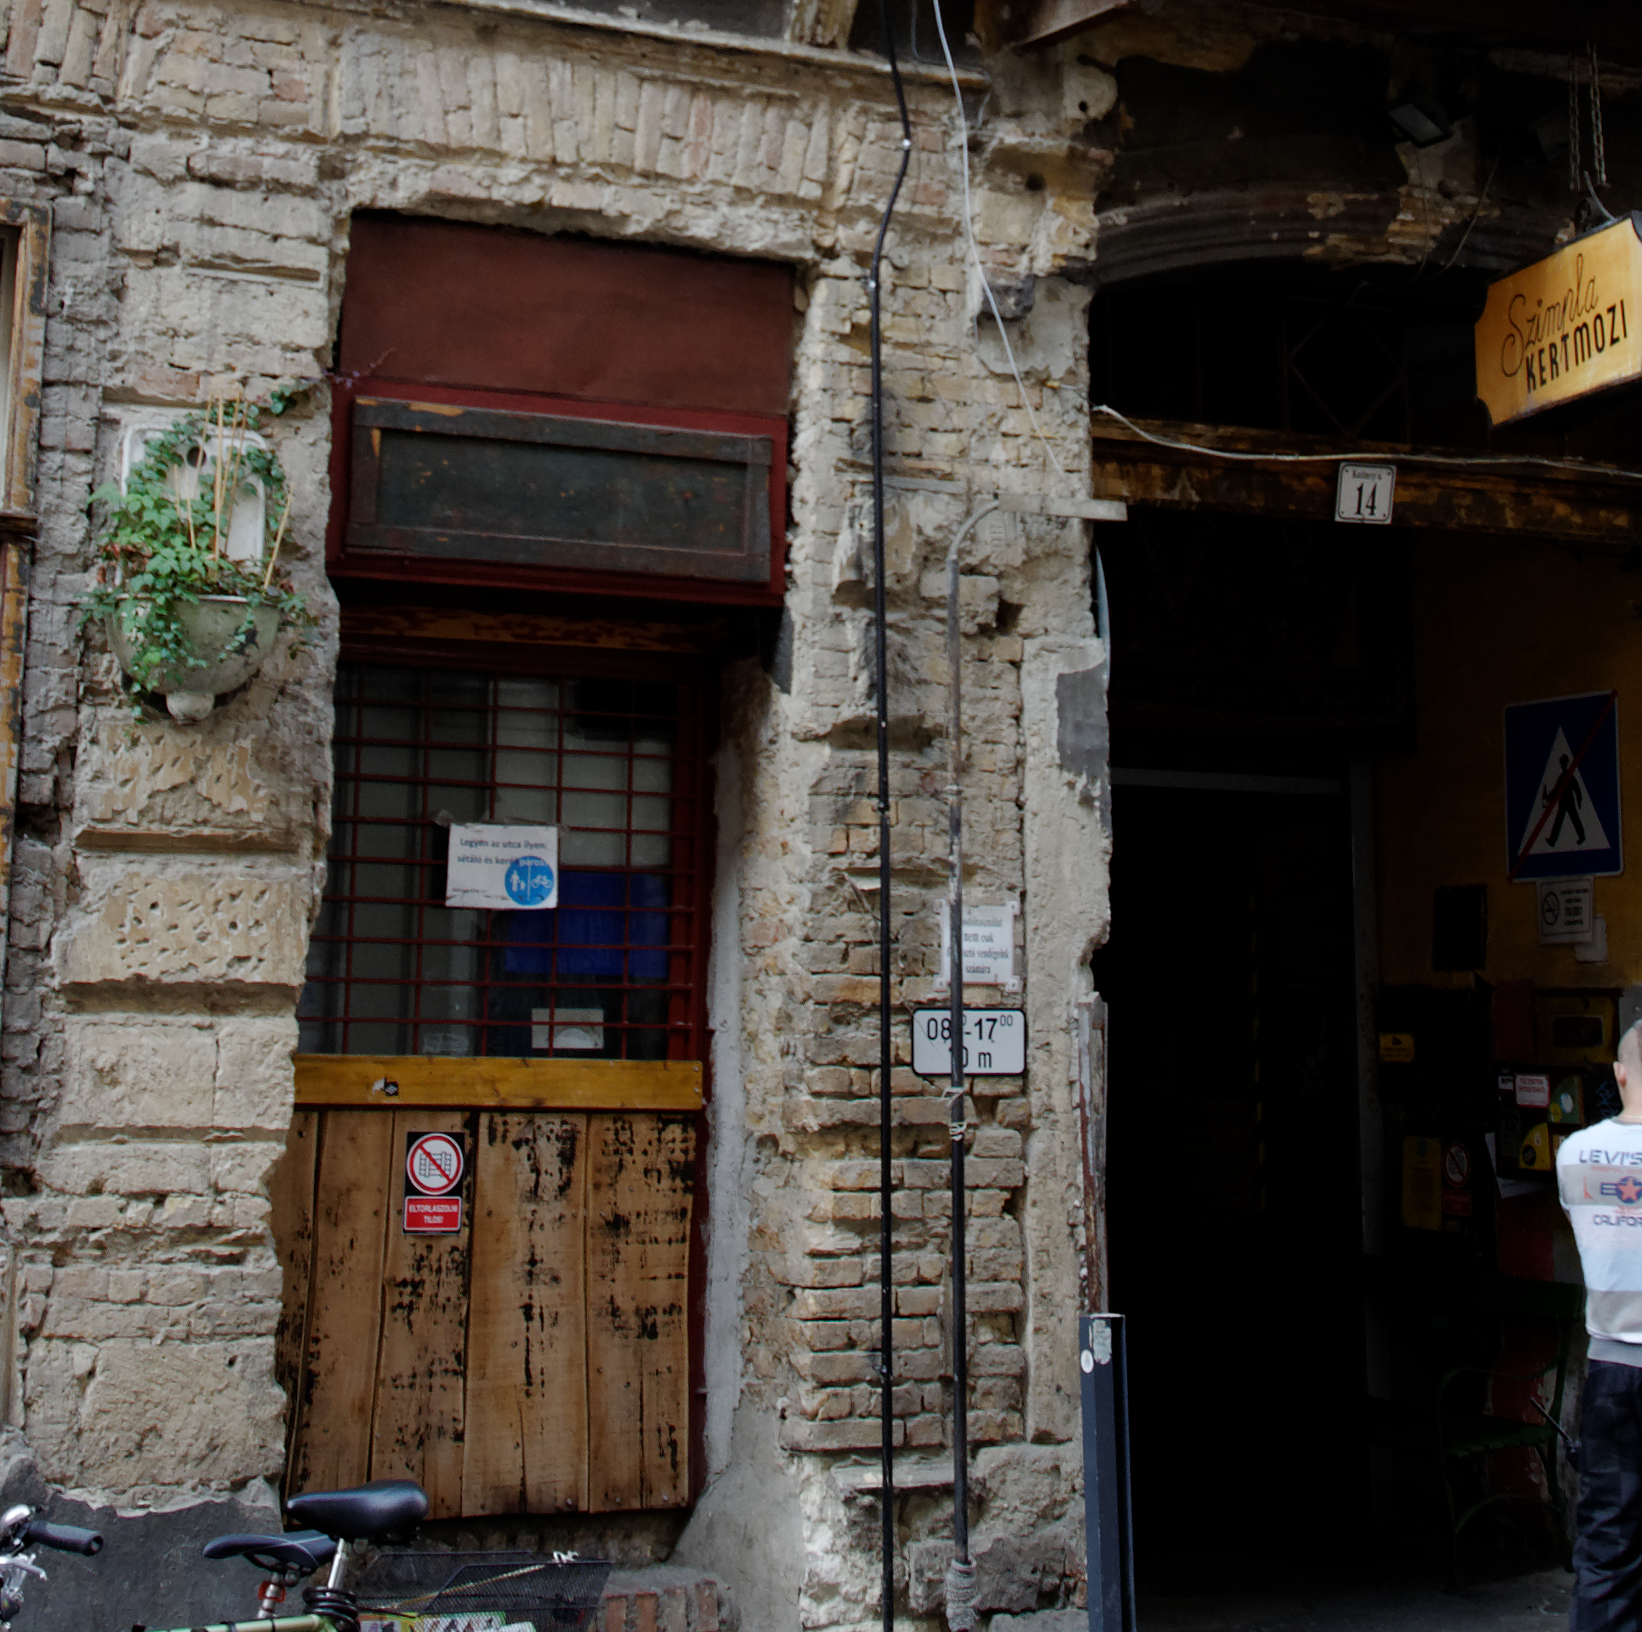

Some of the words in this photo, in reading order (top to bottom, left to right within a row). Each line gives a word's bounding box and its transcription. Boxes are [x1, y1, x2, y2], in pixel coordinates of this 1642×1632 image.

[1501, 253, 1599, 377] Szimpla
[1525, 299, 1628, 393] KERTMOZI
[1355, 482, 1377, 516] 14
[978, 1051, 992, 1068] m
